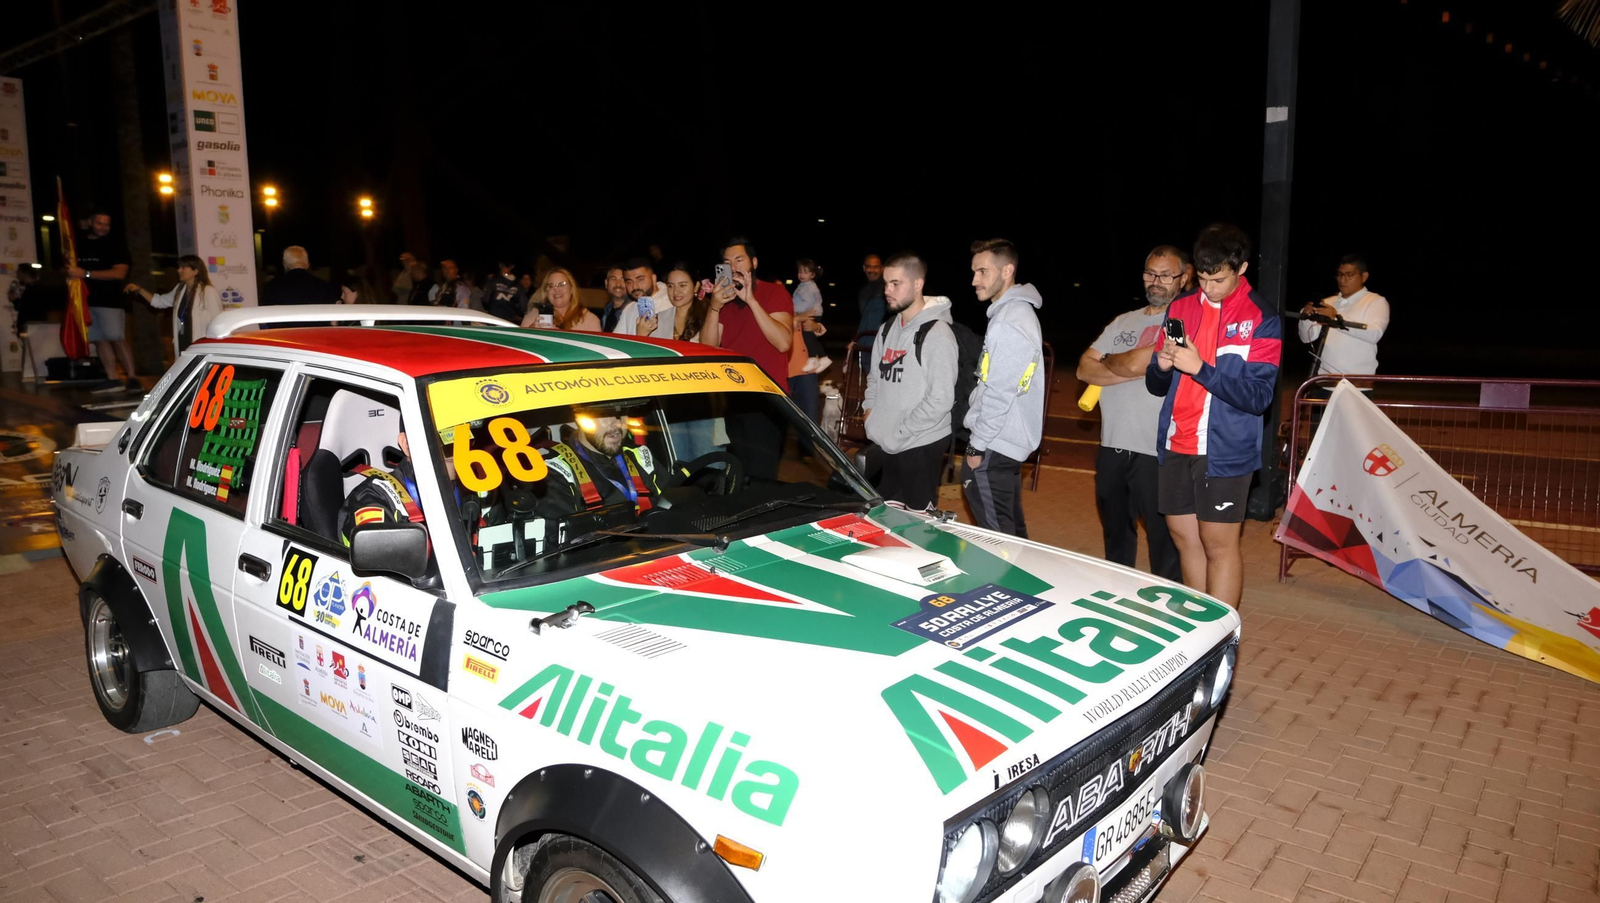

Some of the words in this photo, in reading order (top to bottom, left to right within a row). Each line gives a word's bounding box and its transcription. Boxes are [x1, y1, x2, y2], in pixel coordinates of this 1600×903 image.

[197, 140, 240, 152] gasolia
[201, 185, 244, 199] Phonika
[525, 376, 613, 395] AUTOMÓVIL
[615, 374, 649, 386] CLUB
[650, 373, 670, 383] DE
[670, 369, 721, 382] ALMERÍA
[190, 364, 236, 431] 68
[453, 417, 549, 492] 68
[1410, 494, 1470, 546] CIUDAD
[1418, 489, 1540, 585] ALMERÍA
[279, 553, 312, 611] 68
[315, 610, 325, 623] 30
[928, 595, 956, 608] 68
[376, 608, 407, 632] COSTA
[408, 624, 421, 638] DE
[938, 620, 973, 638] COSTA
[972, 612, 985, 623] DE
[984, 597, 1025, 617] ALMERÍA
[249, 634, 287, 669] PIRELLI
[363, 624, 418, 662] ALMERÍA
[463, 629, 511, 661] sparco
[465, 657, 497, 681] PIRELLI
[393, 686, 412, 707] OMP
[881, 586, 1231, 796] Alitalia
[1082, 696, 1123, 725] WORLD
[1121, 676, 1153, 703] RALLY
[1149, 653, 1190, 684] CHAMPION
[404, 716, 440, 744] brembo
[497, 663, 800, 827] Alitalia
[398, 731, 437, 760] KONI
[402, 748, 438, 775] SEAT
[1007, 753, 1041, 780] IRESA
[405, 768, 442, 795] RECARO
[405, 783, 451, 814] ABARTH
[413, 798, 448, 825] sparco
[1095, 824, 1115, 862] GR
